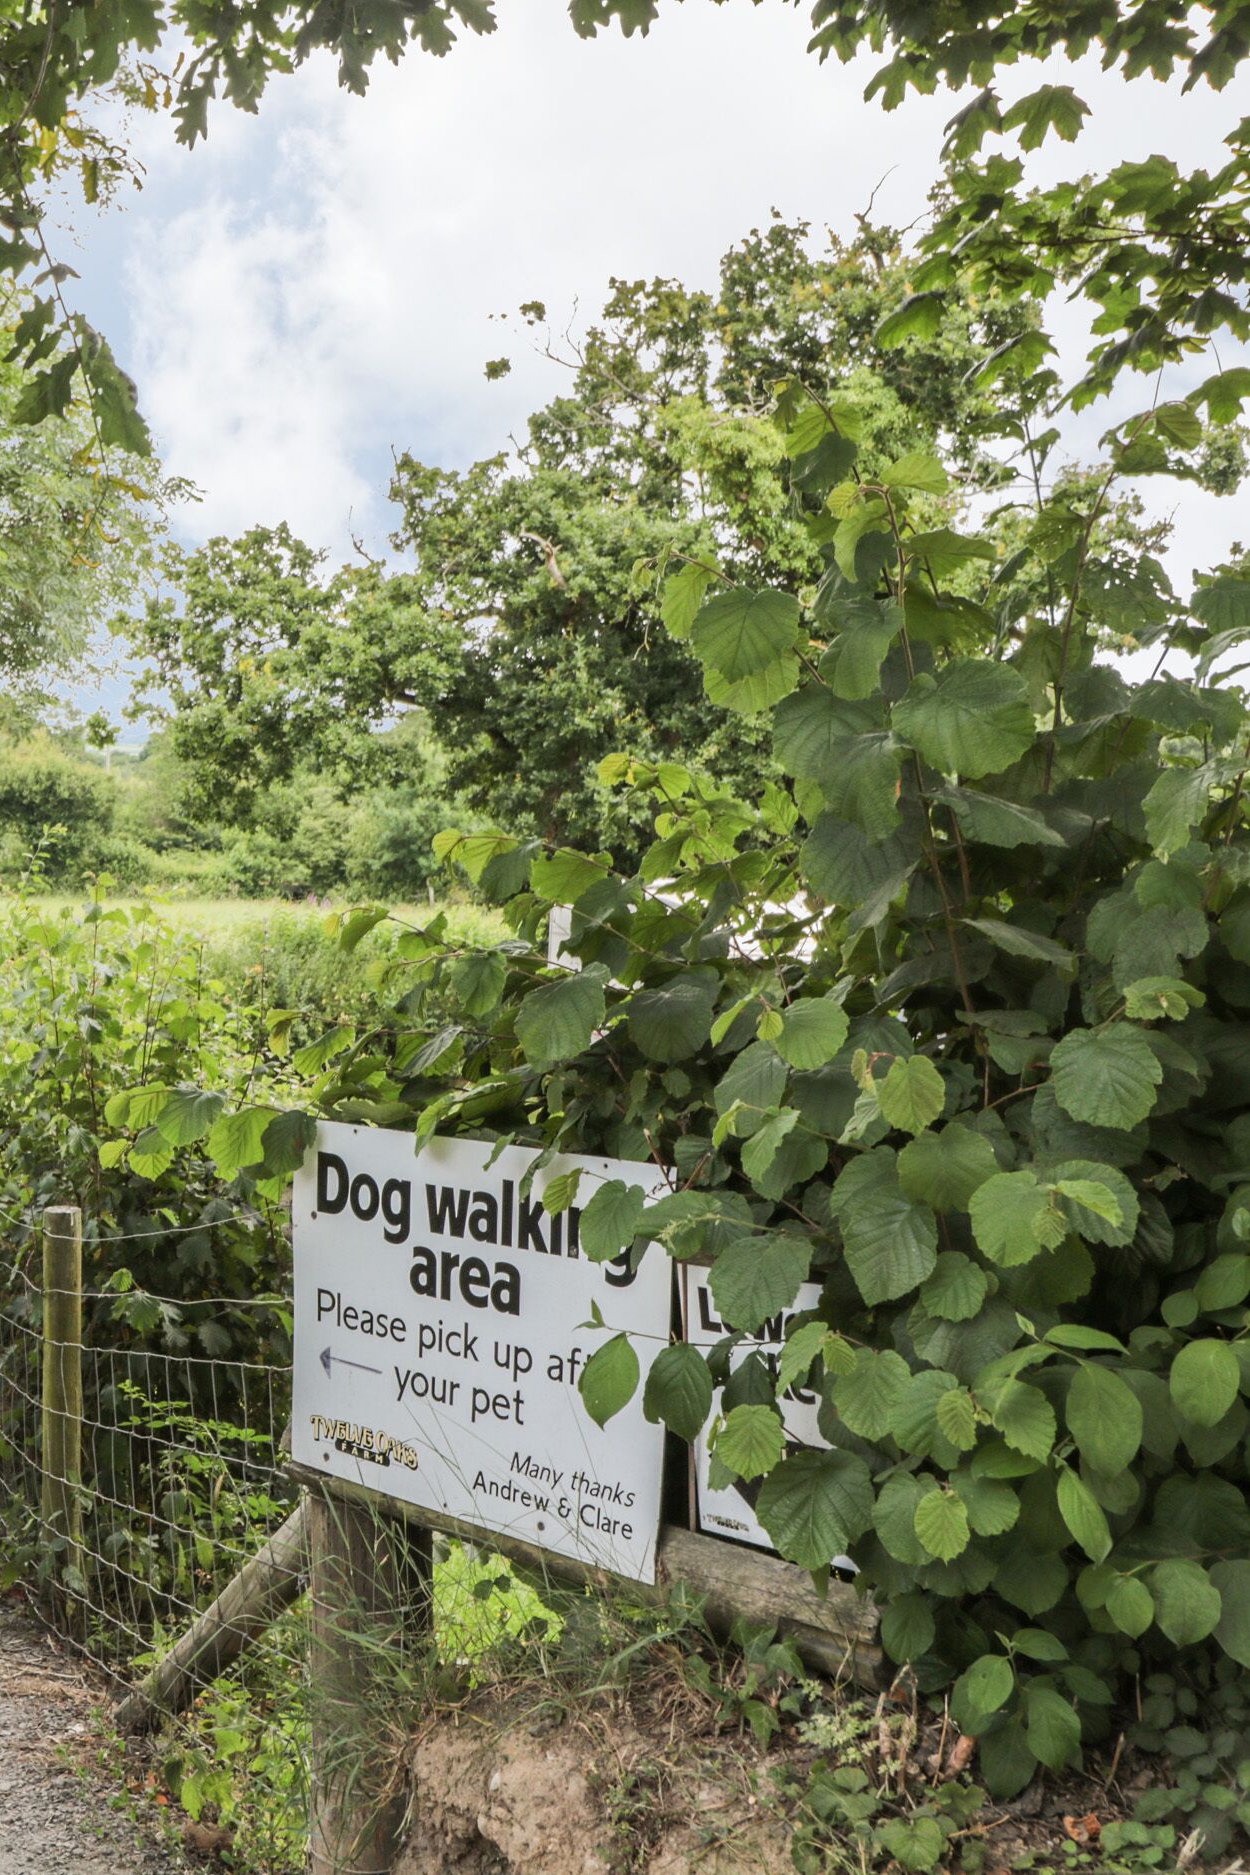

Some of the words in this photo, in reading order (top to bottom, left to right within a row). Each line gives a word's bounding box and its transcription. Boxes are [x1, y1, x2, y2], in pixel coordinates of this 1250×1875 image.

[316, 1150, 412, 1245] Dog
[409, 1245, 521, 1316] area
[316, 1287, 407, 1342] Please
[418, 1319, 479, 1362] pick
[493, 1341, 533, 1382] up
[393, 1365, 460, 1406] your
[471, 1386, 525, 1426] pet
[310, 1414, 374, 1449] TWELVE
[375, 1429, 419, 1470] OAKS
[341, 1442, 384, 1464] FARM
[471, 1470, 550, 1512] Andrew
[557, 1497, 572, 1519] &
[579, 1503, 634, 1540] Clare
[509, 1451, 564, 1490] Many
[570, 1470, 637, 1508] thanks
